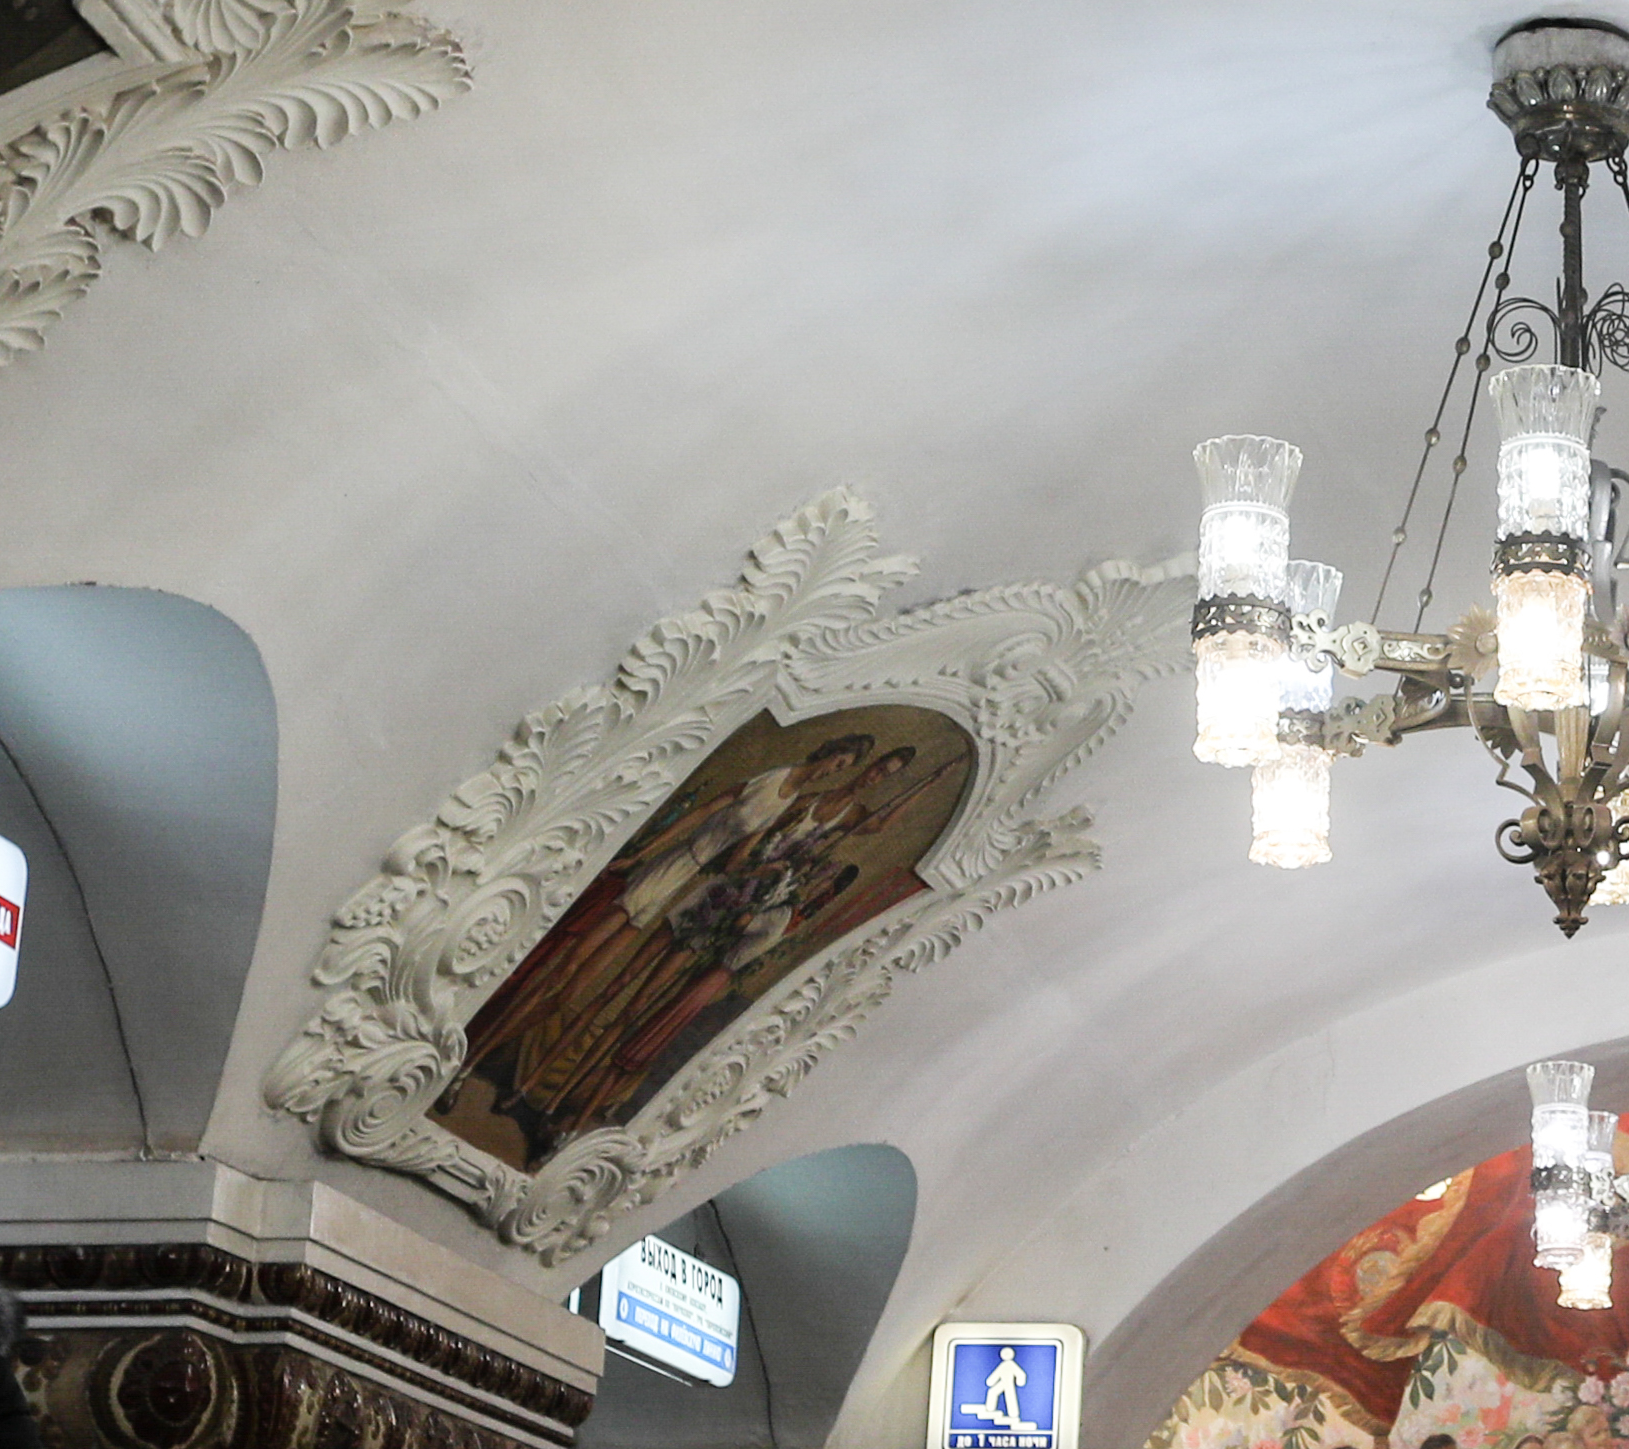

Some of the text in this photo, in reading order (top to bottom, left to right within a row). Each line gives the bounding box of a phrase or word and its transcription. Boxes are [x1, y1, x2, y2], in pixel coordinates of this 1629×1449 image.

[640, 1237, 677, 1285] ВЫХОД
[681, 1258, 687, 1285] В
[691, 1263, 723, 1310] ГОРОД
[956, 1433, 1048, 1449] ДО 1 ЧАСА НОЧИ
